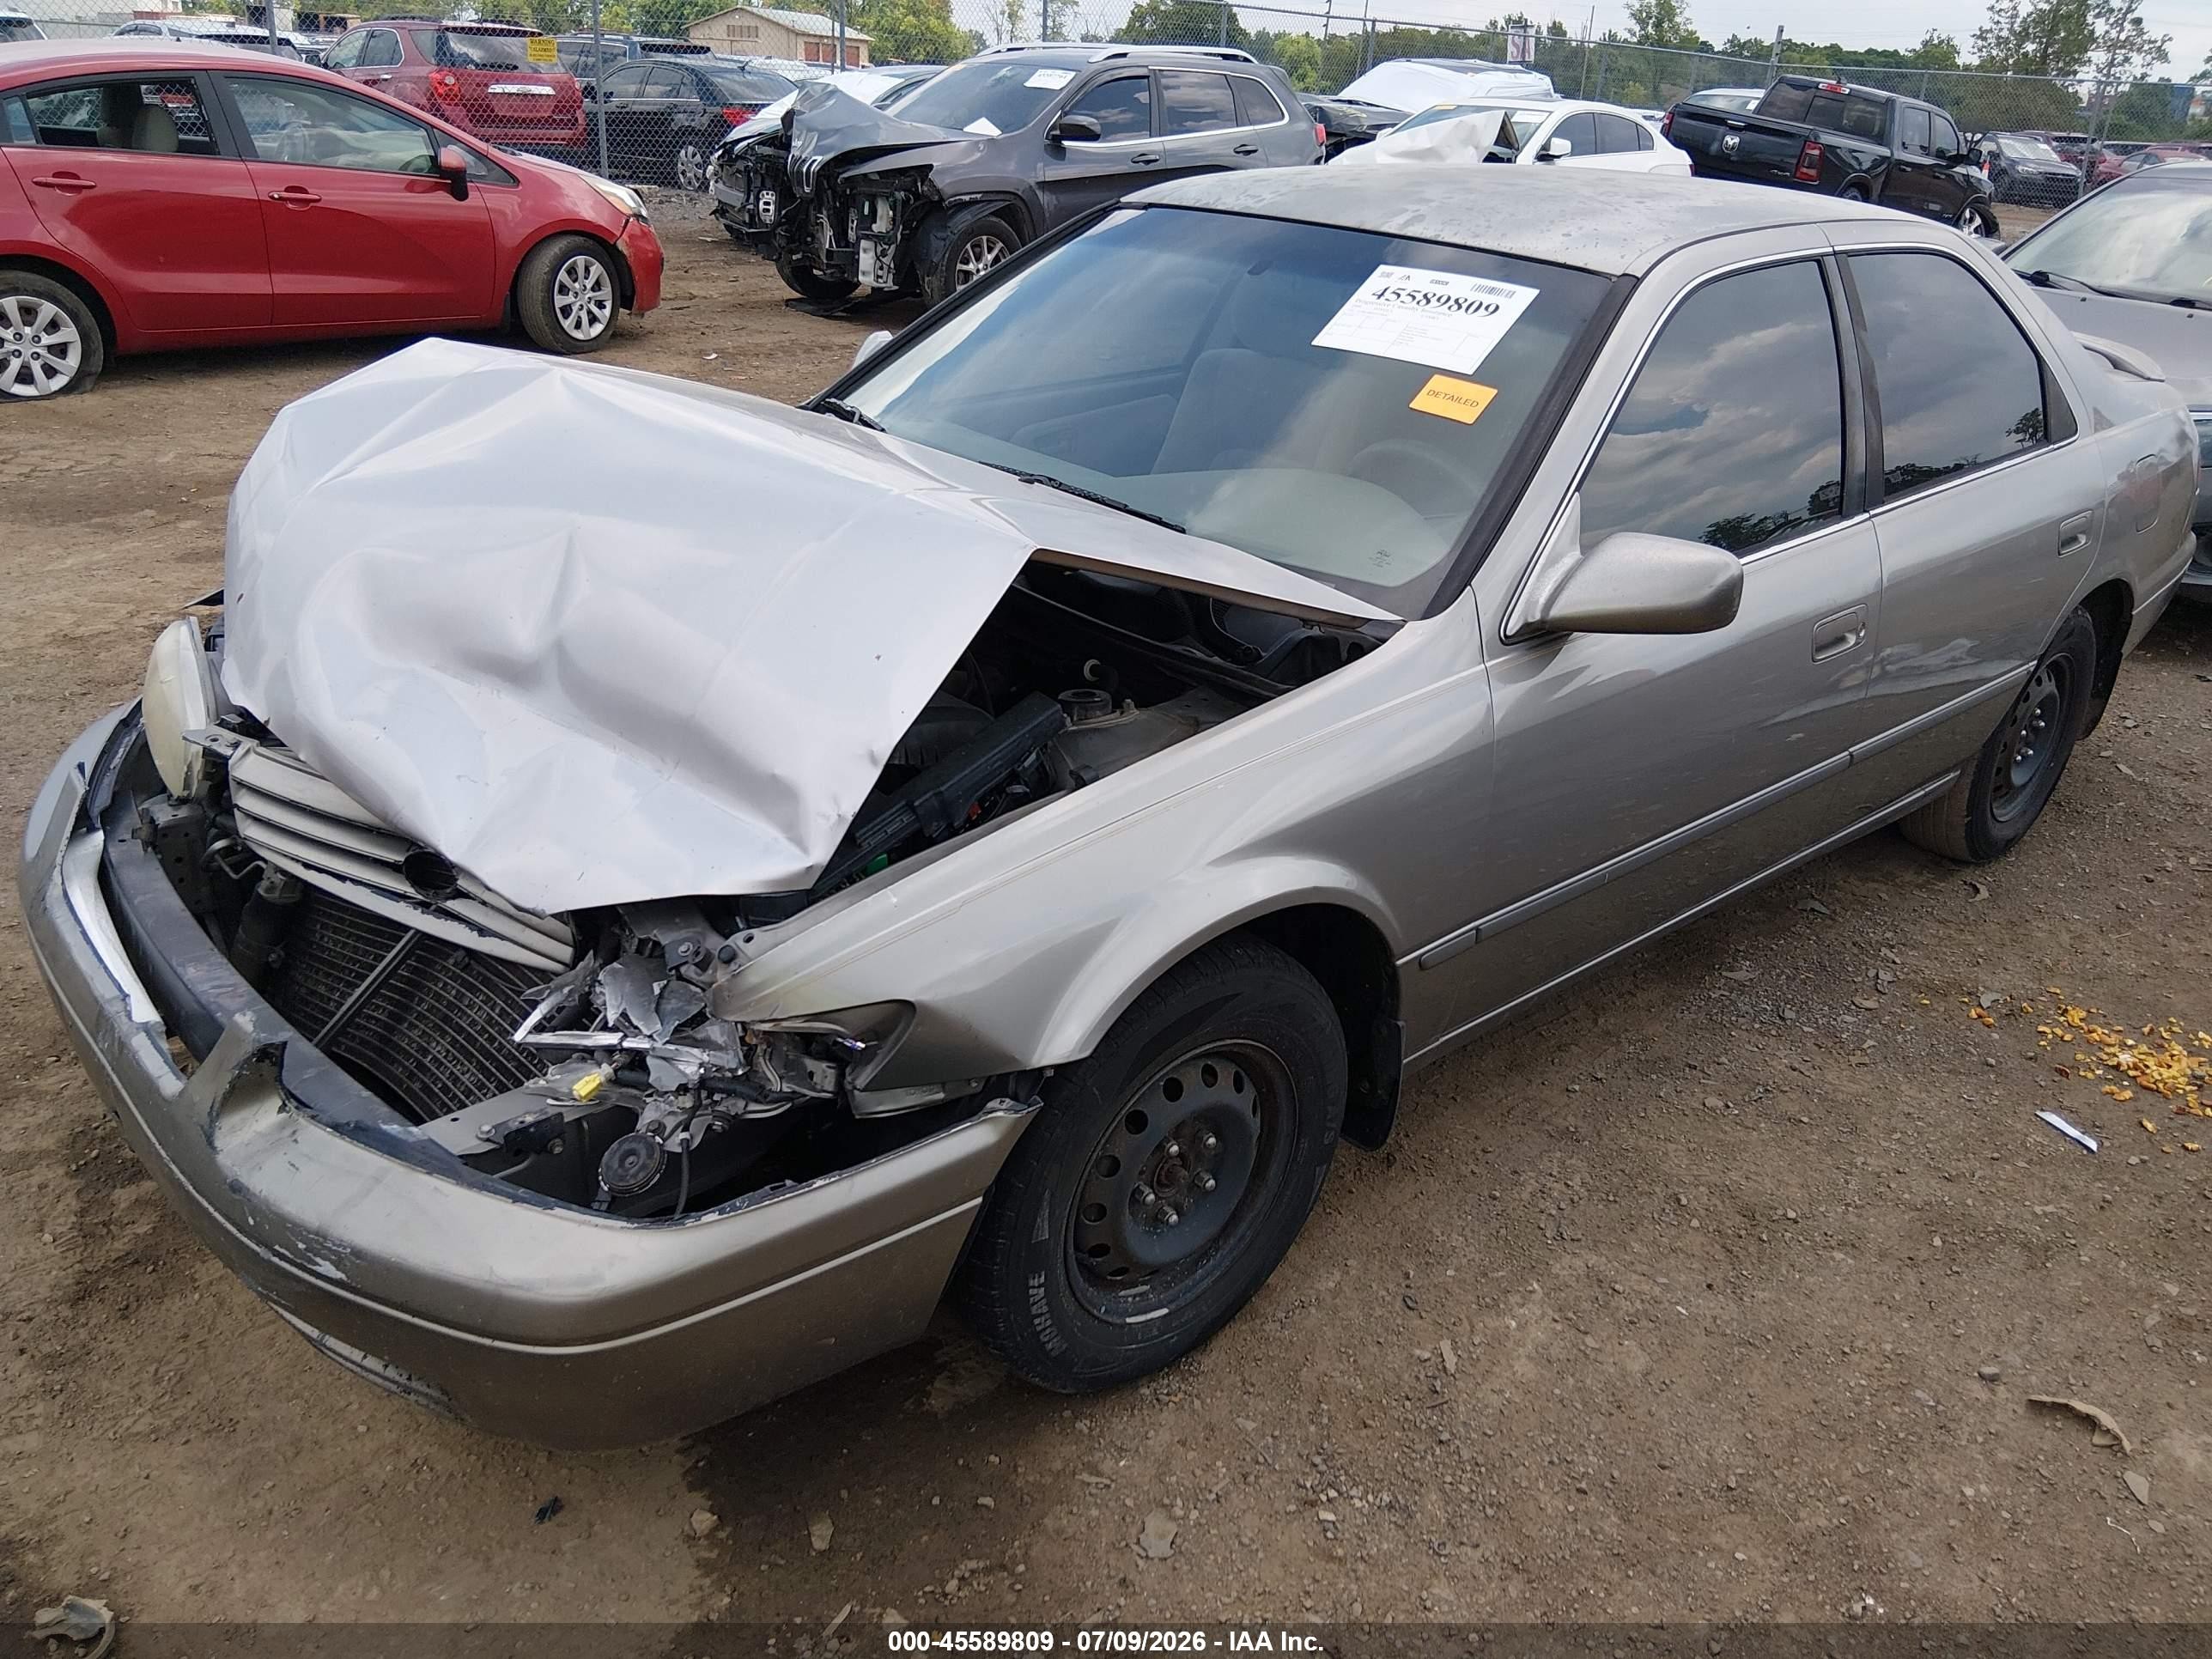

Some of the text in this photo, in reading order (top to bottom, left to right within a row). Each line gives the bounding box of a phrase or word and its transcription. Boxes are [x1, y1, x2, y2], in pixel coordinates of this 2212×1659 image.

[530, 38, 556, 46] WARNING
[1371, 285, 1500, 318] 45589809
[1426, 389, 1480, 408] DETAILED
[1028, 1270, 1068, 1357] MOHAVE
